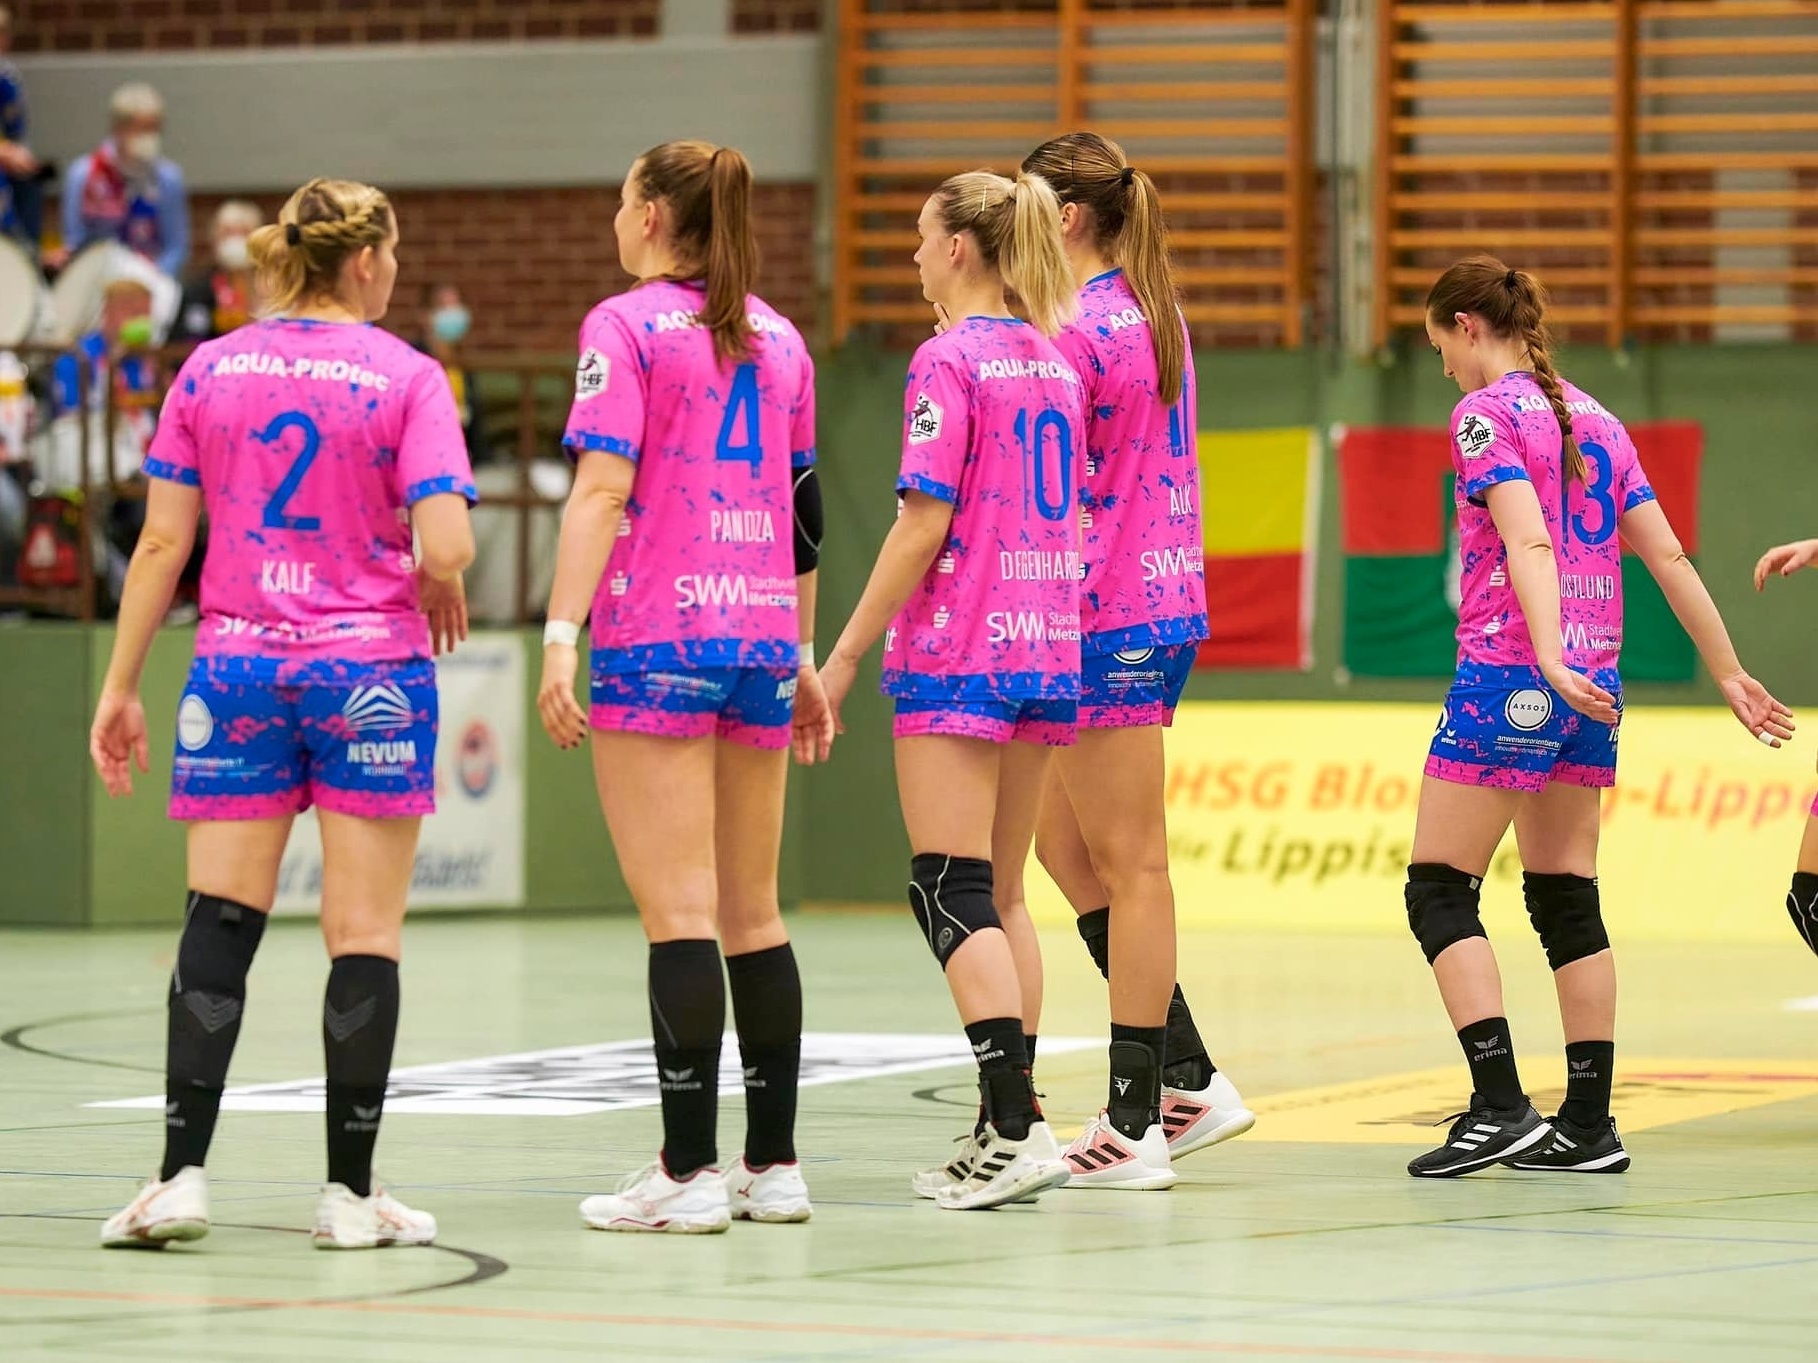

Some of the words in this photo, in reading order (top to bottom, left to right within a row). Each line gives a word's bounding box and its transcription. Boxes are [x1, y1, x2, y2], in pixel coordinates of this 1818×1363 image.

[213, 352, 391, 391] AQUA-PROtec
[716, 362, 763, 478] 4
[914, 420, 938, 434] HBF
[1470, 427, 1493, 445] HBF
[258, 411, 321, 530] 2
[1013, 407, 1074, 521] 10
[1561, 442, 1618, 546] 13
[711, 511, 776, 542] PANDZA
[261, 559, 316, 594] KALF
[1141, 546, 1188, 581] SWM
[674, 575, 748, 608] SWM
[986, 611, 1046, 642] SWM
[1513, 702, 1546, 712] AXSOS
[346, 740, 417, 764] NEVUM
[1166, 760, 1291, 811] HSG
[976, 1050, 1005, 1064] rima
[1474, 1047, 1507, 1062] erima
